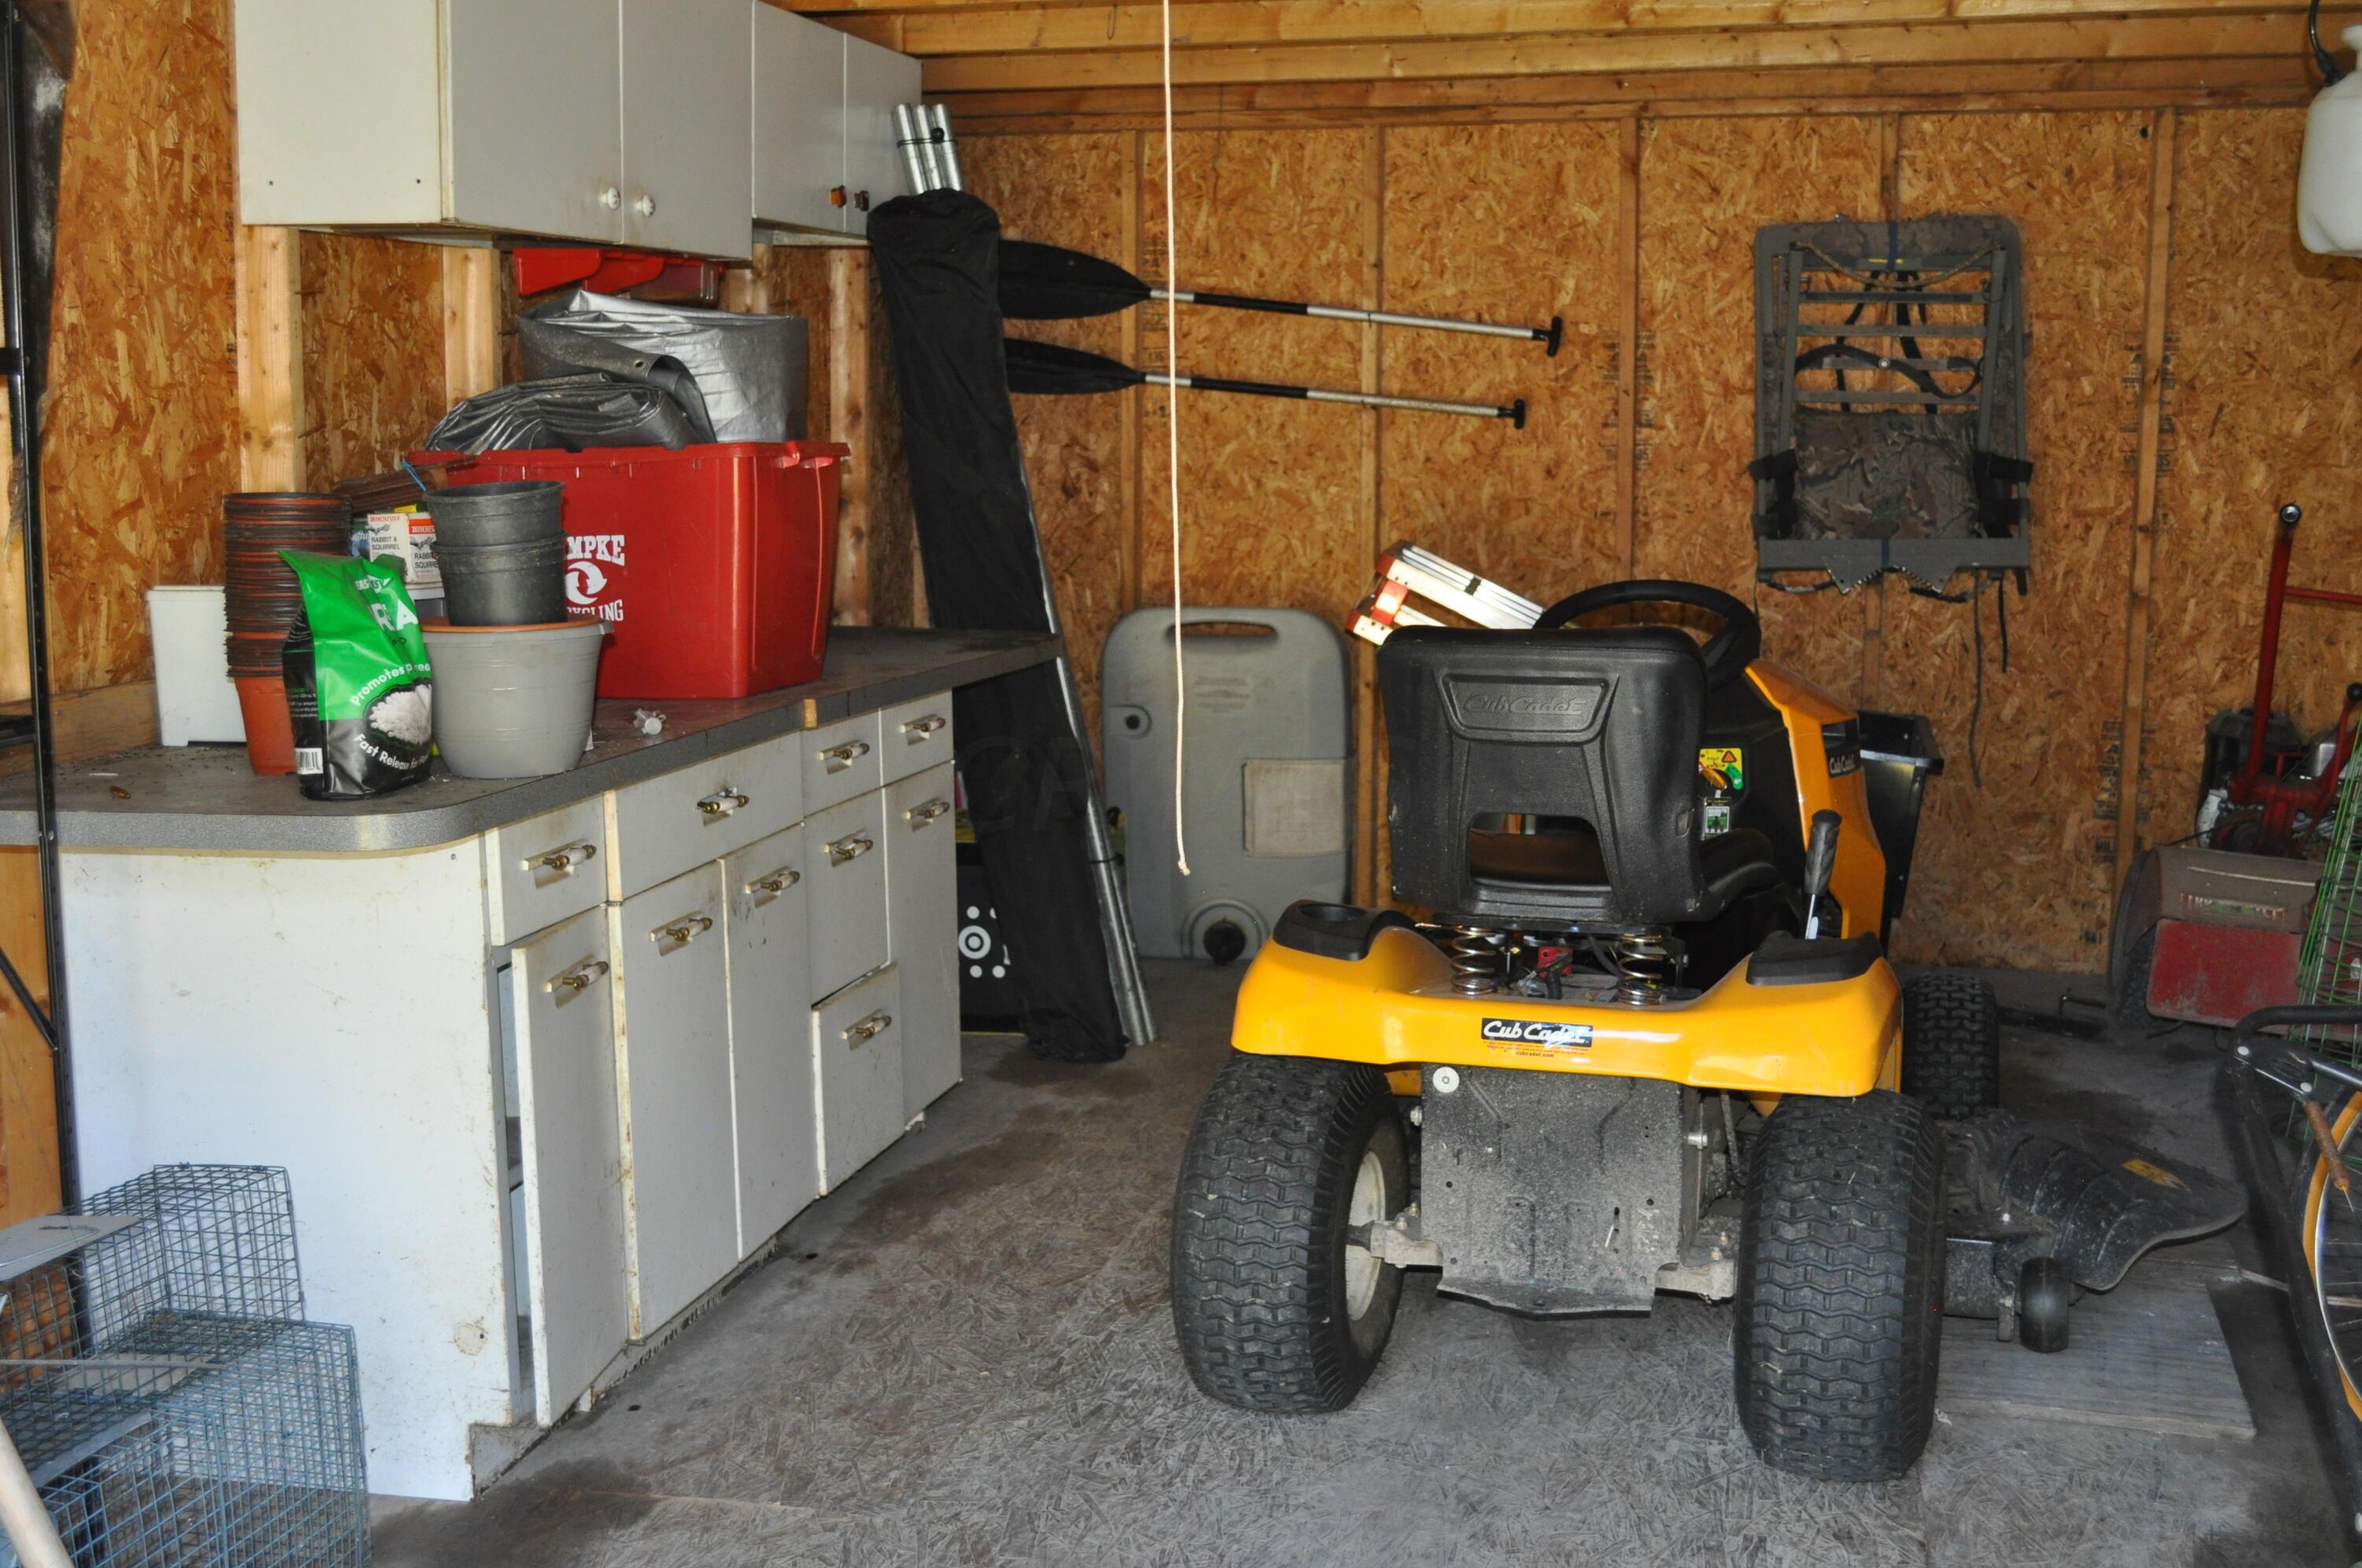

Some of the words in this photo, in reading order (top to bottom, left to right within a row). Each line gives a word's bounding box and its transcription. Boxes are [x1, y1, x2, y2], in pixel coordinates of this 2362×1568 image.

[566, 534, 625, 567] MPKE
[350, 666, 405, 706] Promotes
[354, 733, 379, 756] Fast
[379, 751, 409, 771] Release
[1483, 1020, 1523, 1039] Cub
[1523, 1023, 1586, 1044] Cadet
